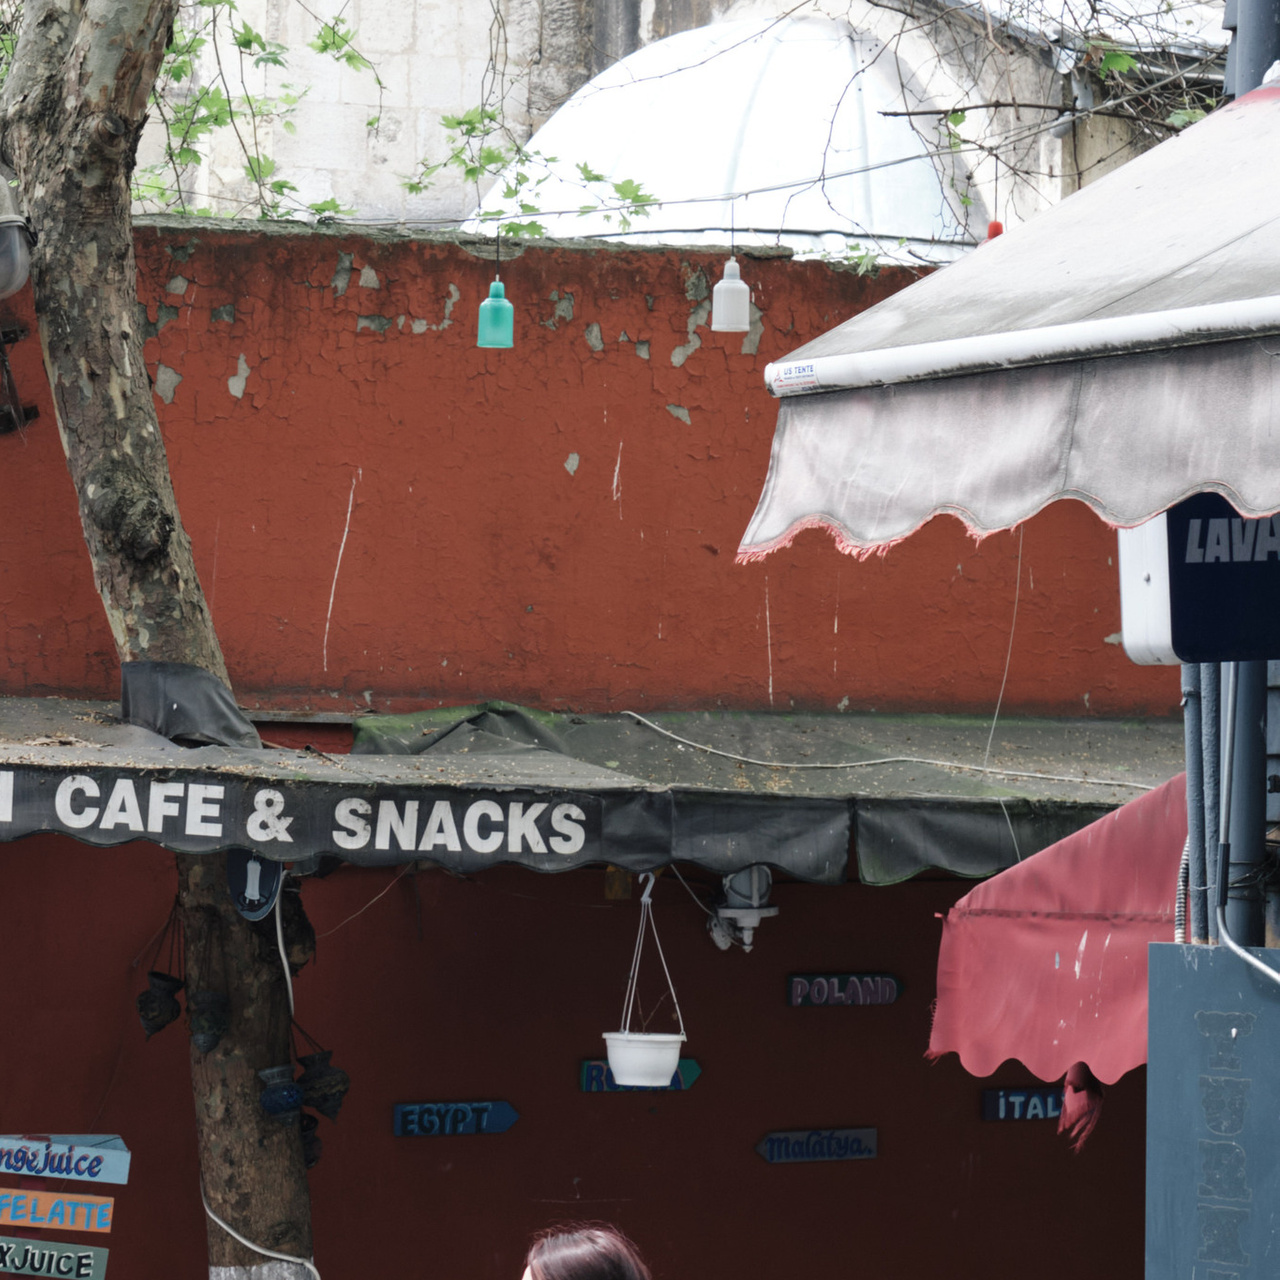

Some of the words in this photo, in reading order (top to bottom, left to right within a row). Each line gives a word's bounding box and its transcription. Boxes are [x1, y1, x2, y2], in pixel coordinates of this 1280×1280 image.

[54, 774, 225, 838] CAFE
[245, 788, 294, 843] &
[332, 797, 587, 855] SNACKS
[792, 975, 897, 1006] POLAND
[400, 1102, 493, 1136] EGYPT
